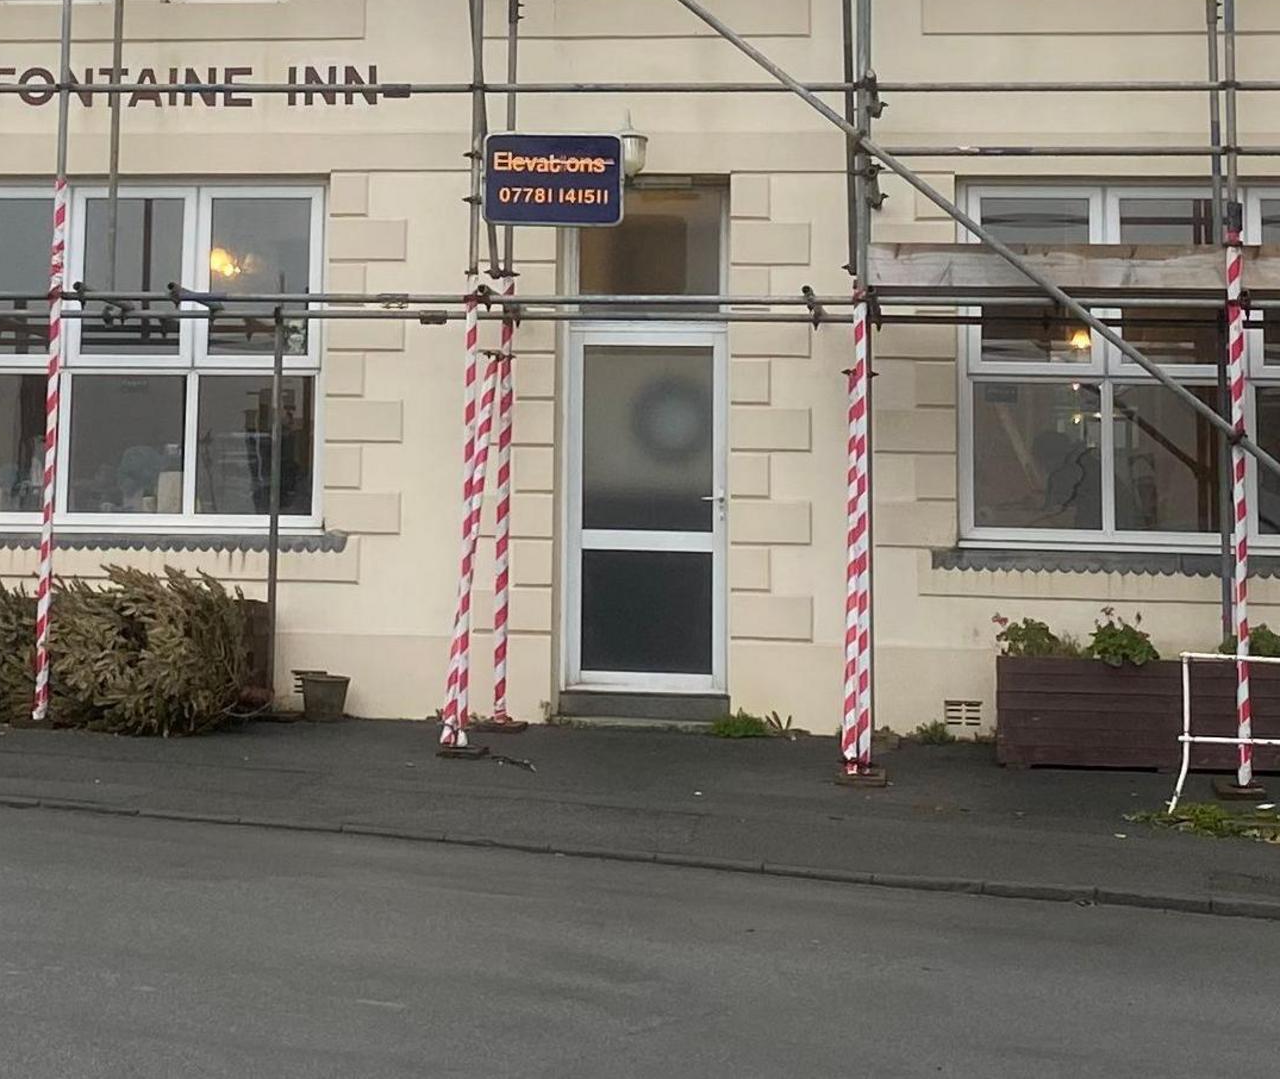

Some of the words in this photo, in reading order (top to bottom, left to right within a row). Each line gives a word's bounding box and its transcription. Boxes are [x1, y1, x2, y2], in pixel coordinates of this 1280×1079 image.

[287, 65, 378, 107] INN
[499, 186, 553, 203] 07781
[559, 187, 609, 205] 141511
